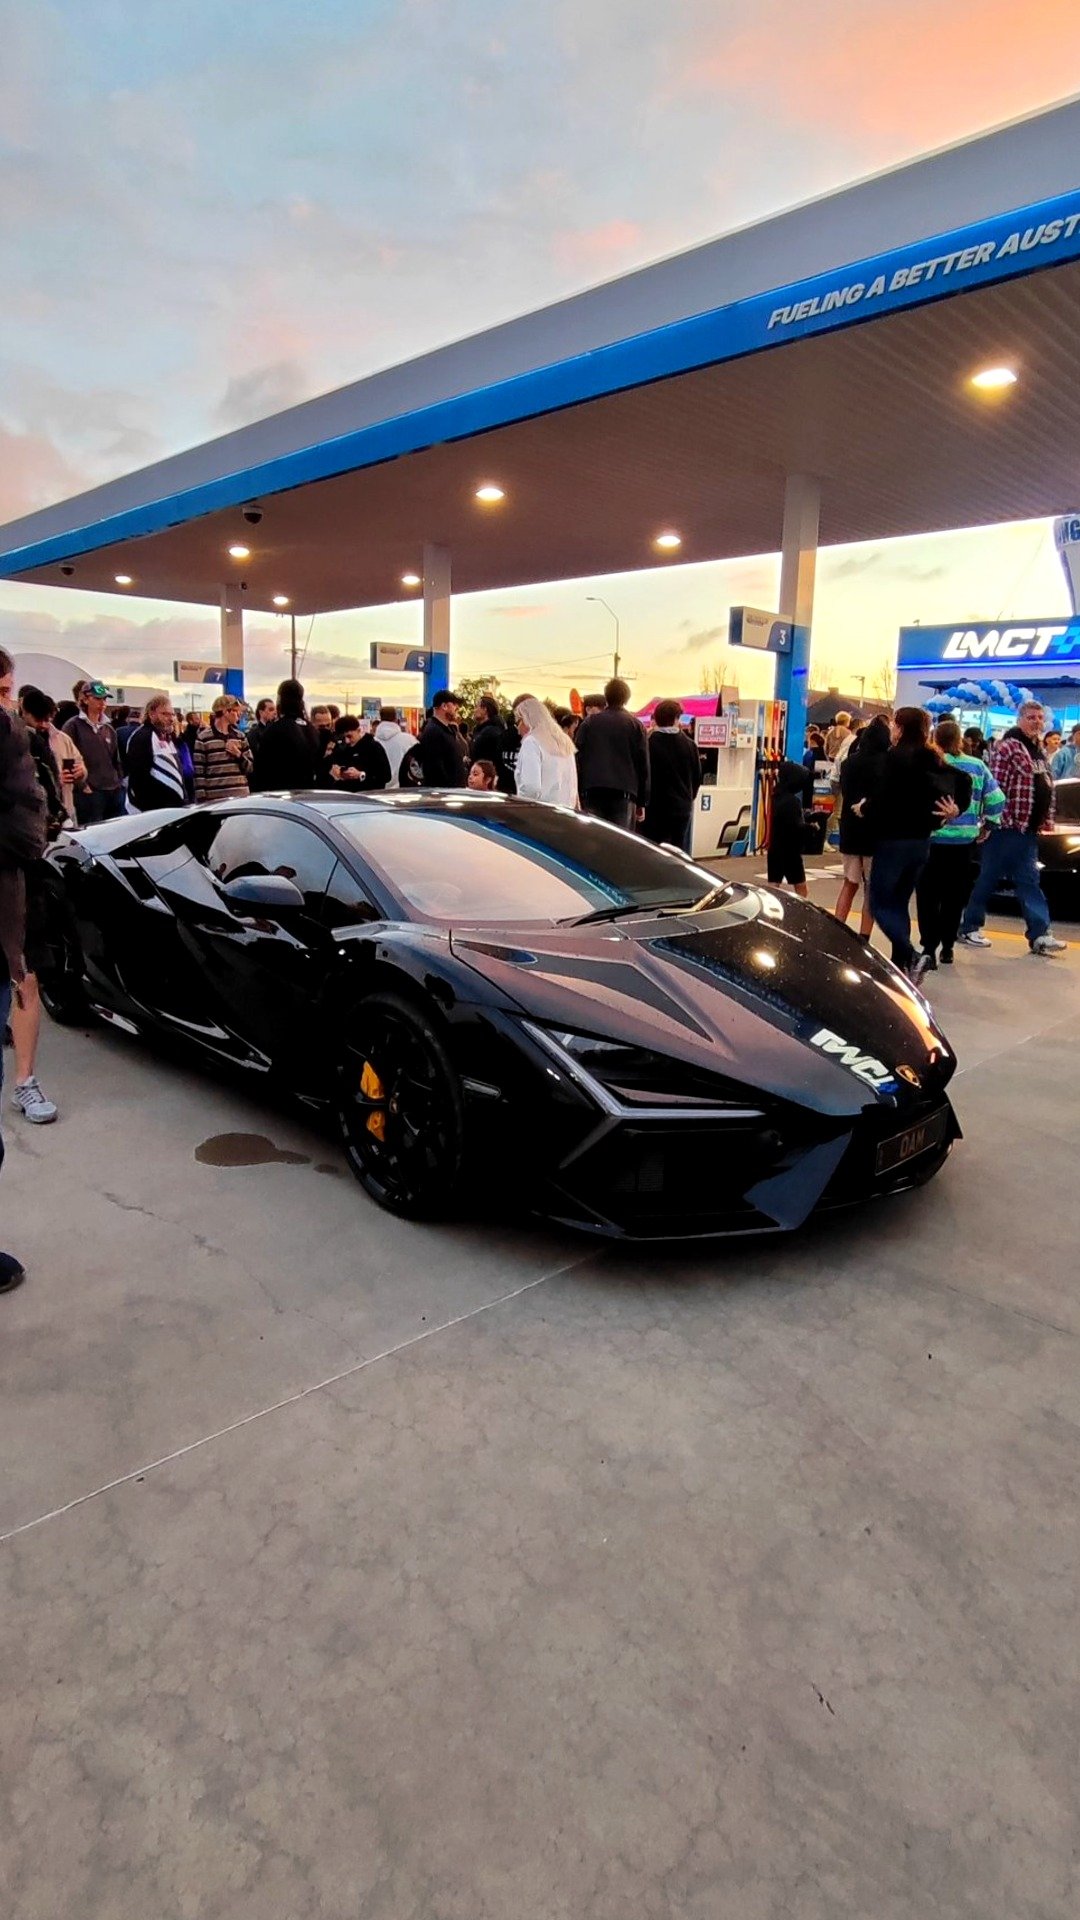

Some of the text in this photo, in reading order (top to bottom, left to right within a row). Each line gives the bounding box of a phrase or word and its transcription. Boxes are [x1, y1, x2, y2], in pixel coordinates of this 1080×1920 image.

[767, 212, 1080, 329] FUELING A BETTER AUST
[779, 629, 786, 645] 3
[417, 656, 425, 668] 5
[215, 672, 222, 681] 7
[702, 796, 710, 809] 3
